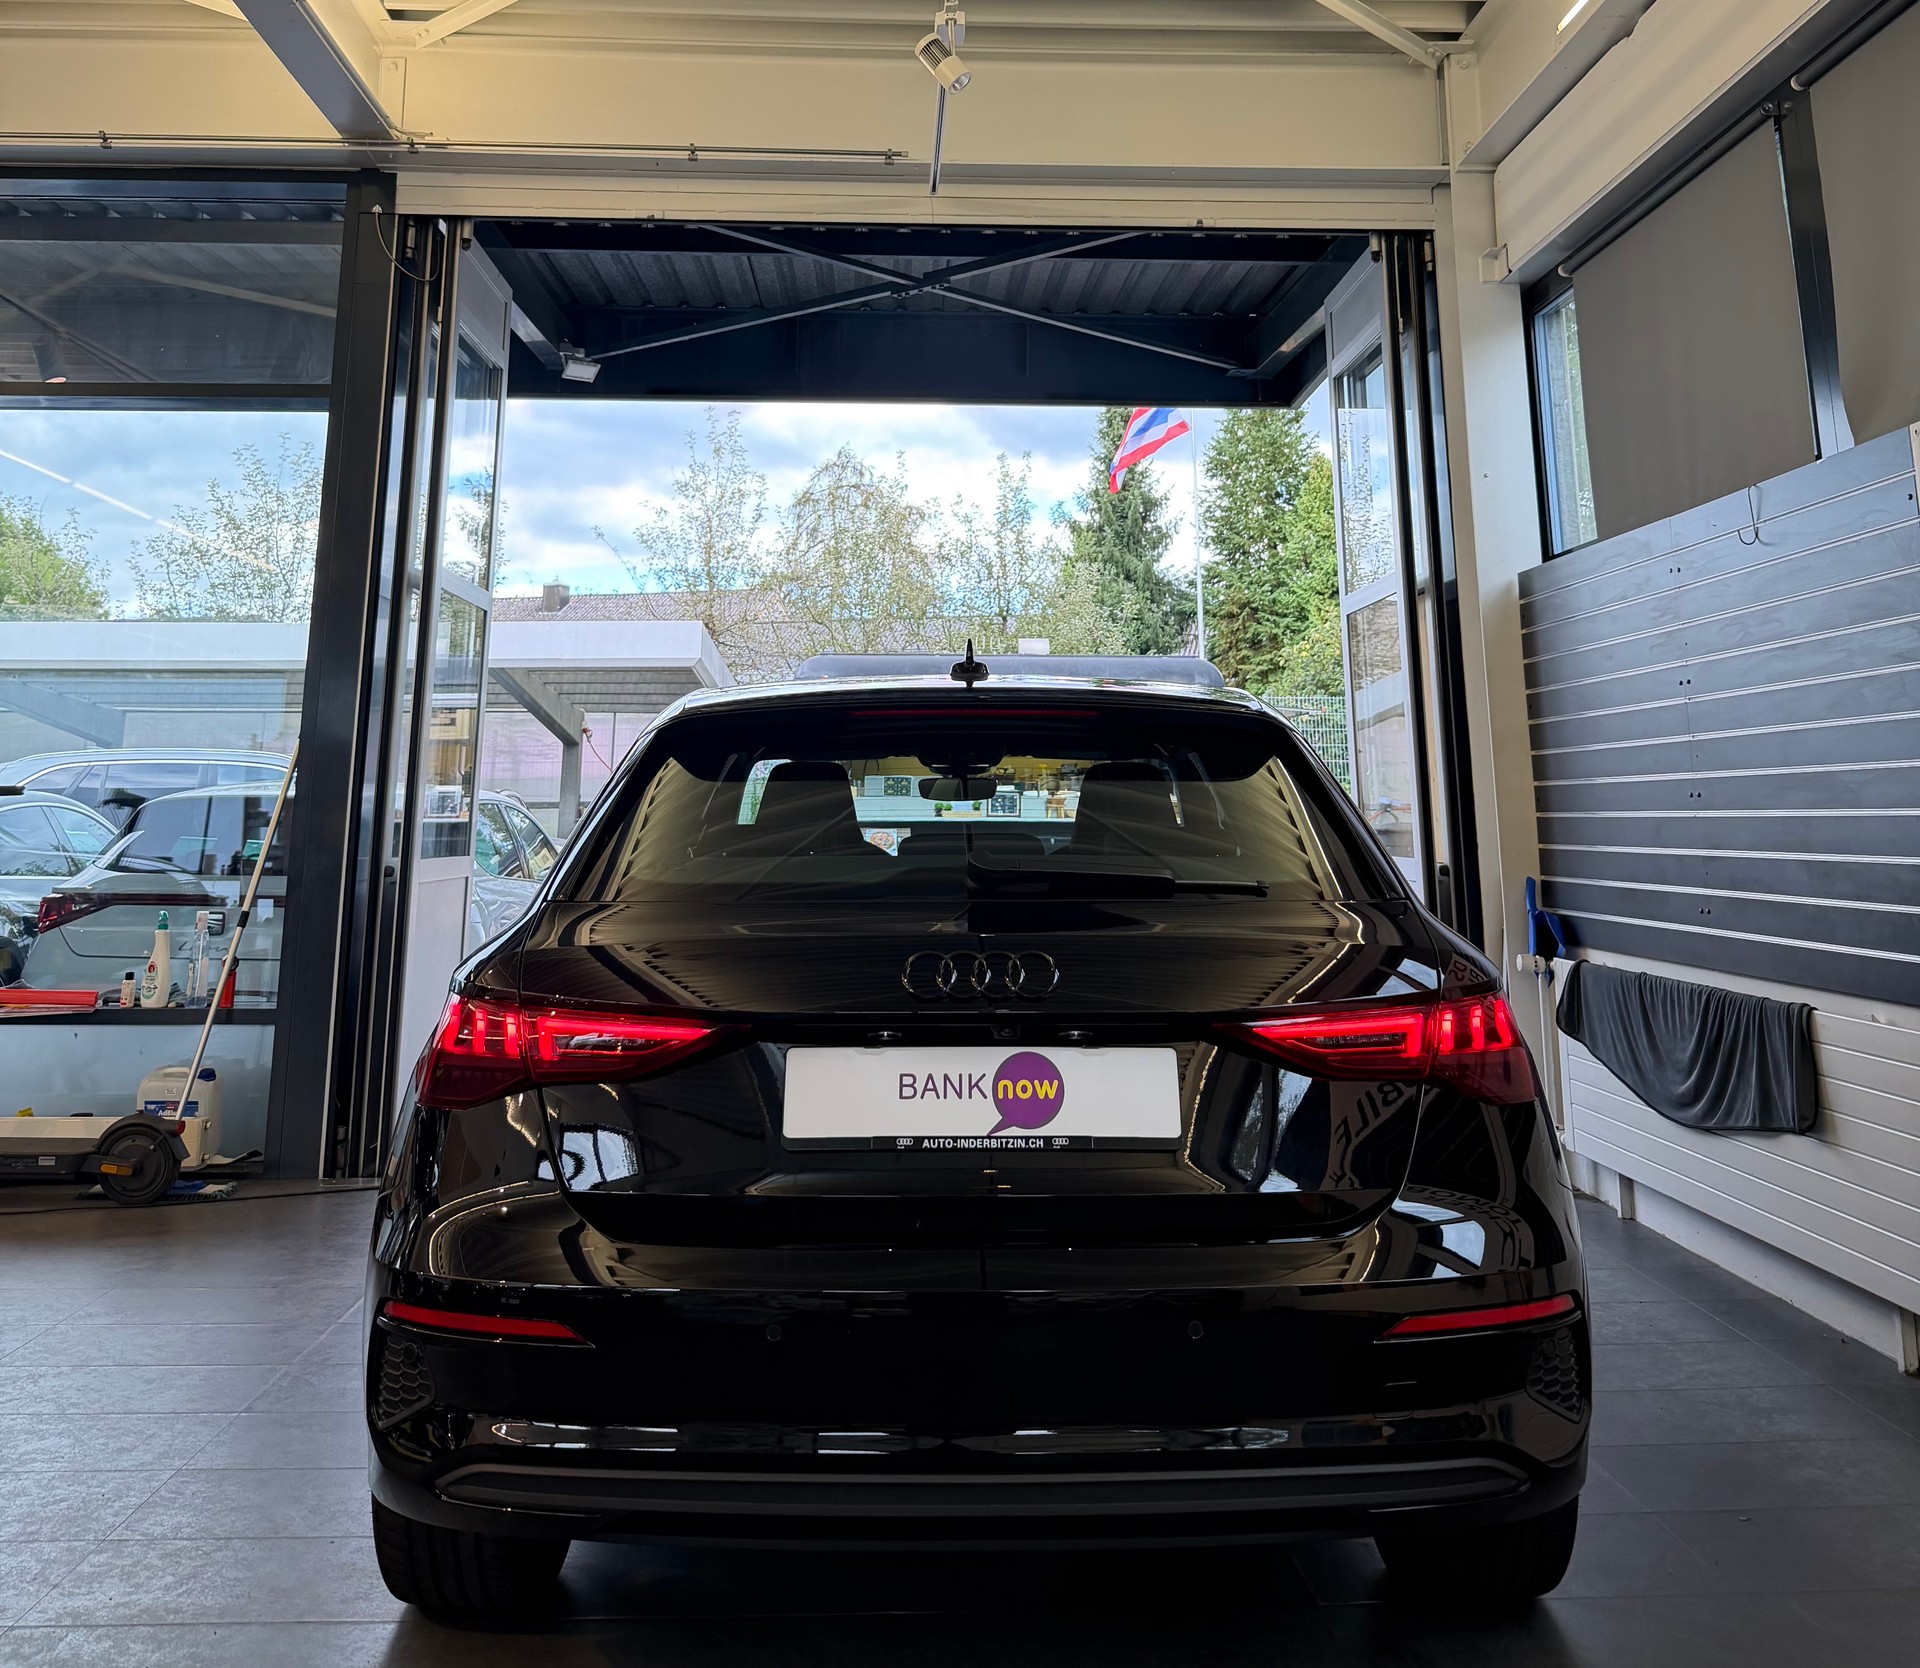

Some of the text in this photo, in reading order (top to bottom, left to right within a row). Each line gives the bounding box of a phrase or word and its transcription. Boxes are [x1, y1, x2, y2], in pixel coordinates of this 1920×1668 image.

[898, 1072, 1059, 1100] BANK now
[921, 1138, 1044, 1149] AUTO-INDERBITZIN.CH
